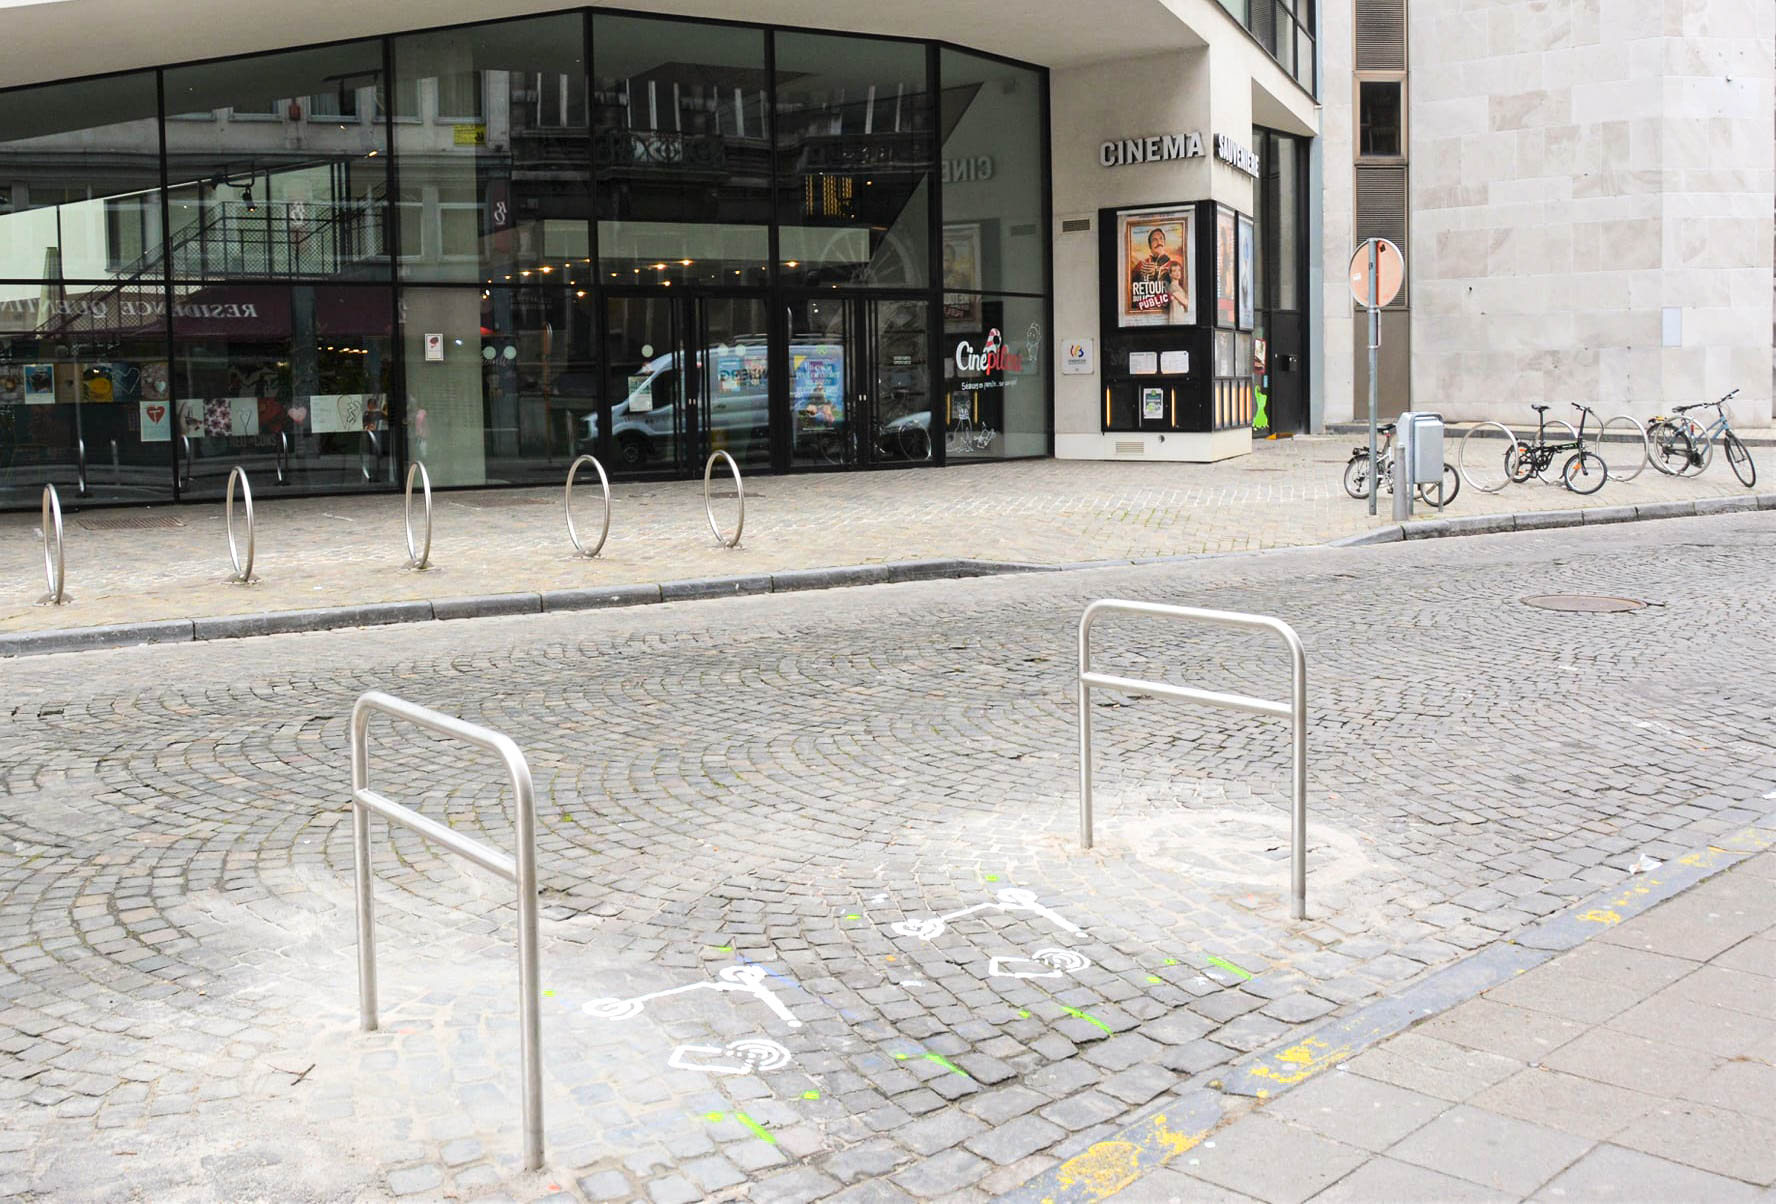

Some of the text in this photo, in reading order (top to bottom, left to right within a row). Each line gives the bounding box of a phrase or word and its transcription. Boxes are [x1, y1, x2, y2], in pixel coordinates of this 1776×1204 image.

[1100, 132, 1205, 167] CINEMA
[1132, 280, 1169, 296] RETOUR
[1138, 293, 1169, 311] PUBLIC
